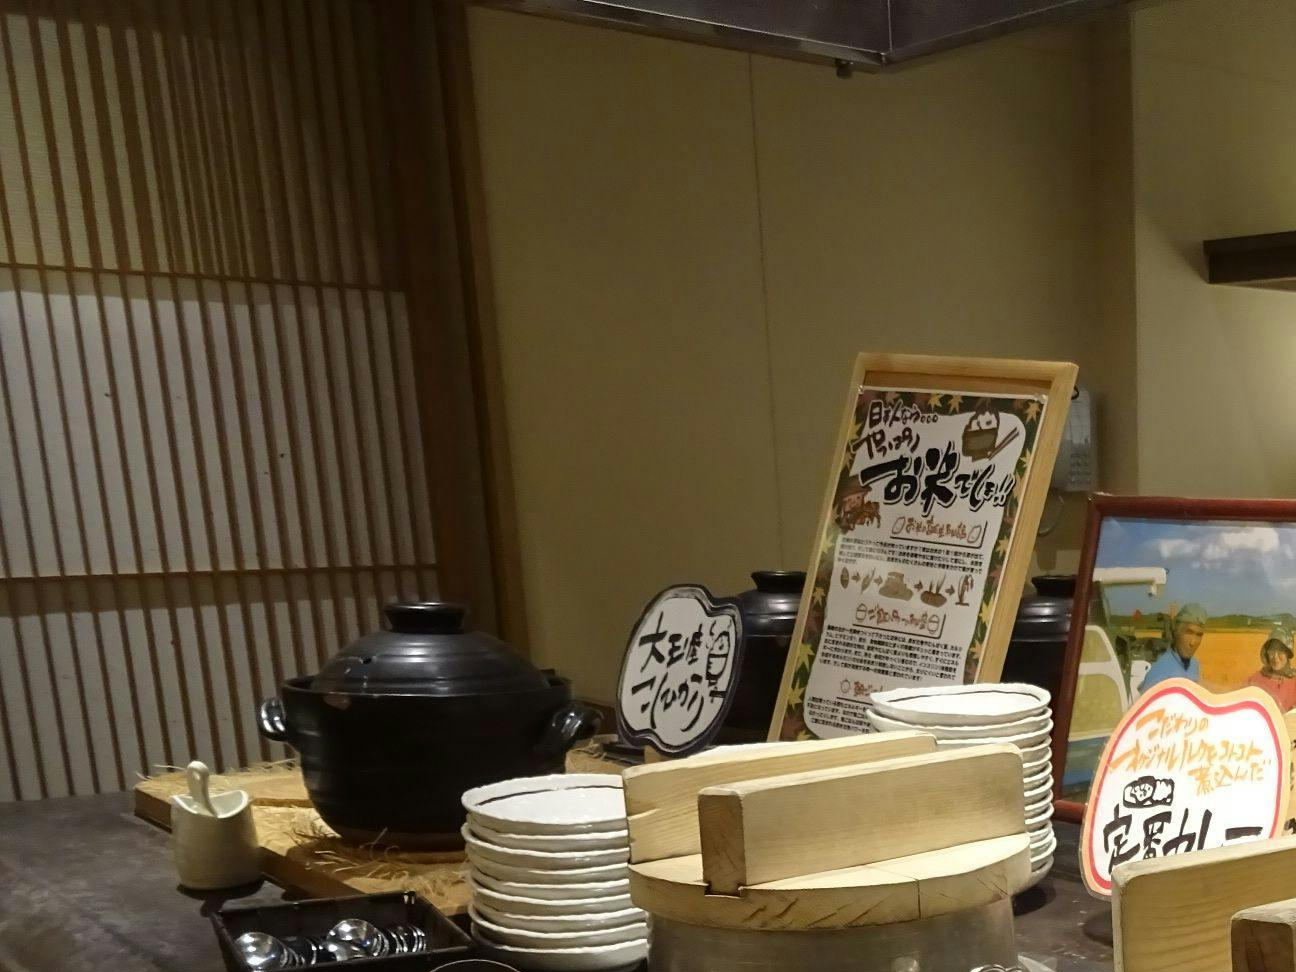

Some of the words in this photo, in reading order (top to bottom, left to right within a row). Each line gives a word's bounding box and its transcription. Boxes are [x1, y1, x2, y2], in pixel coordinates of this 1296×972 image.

[1136, 708, 1209, 741] こだわりの
[1187, 759, 1273, 796] 煮込んだ
